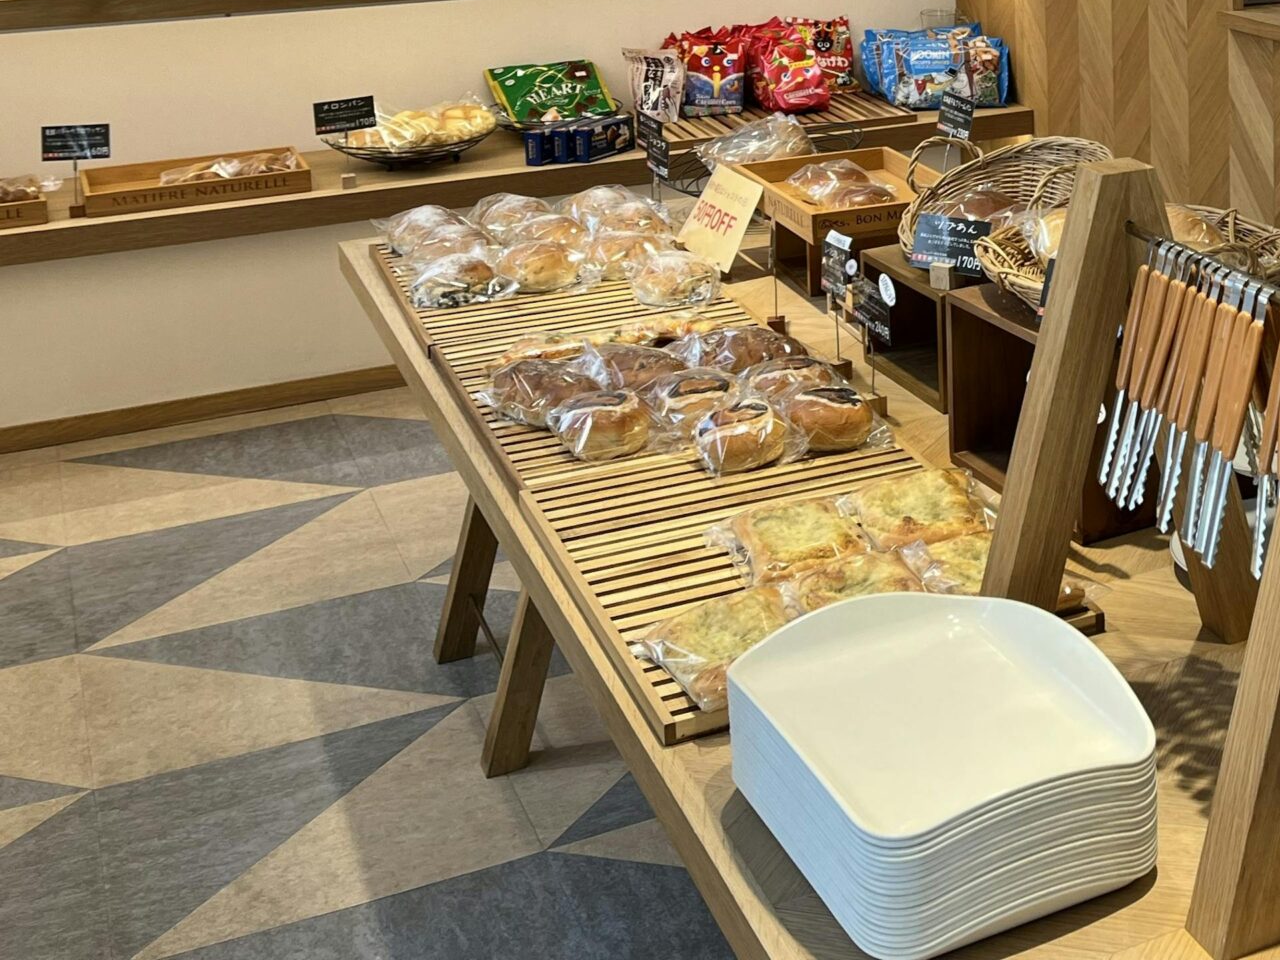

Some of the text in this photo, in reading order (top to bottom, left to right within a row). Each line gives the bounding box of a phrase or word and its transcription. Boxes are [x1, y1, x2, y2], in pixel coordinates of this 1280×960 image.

[526, 82, 585, 105] HEART
[322, 100, 365, 111] メロンパン
[355, 116, 376, 127] 170円
[194, 177, 291, 197] NATURELLE
[855, 213, 882, 226] BON
[956, 255, 981, 271] 170円
